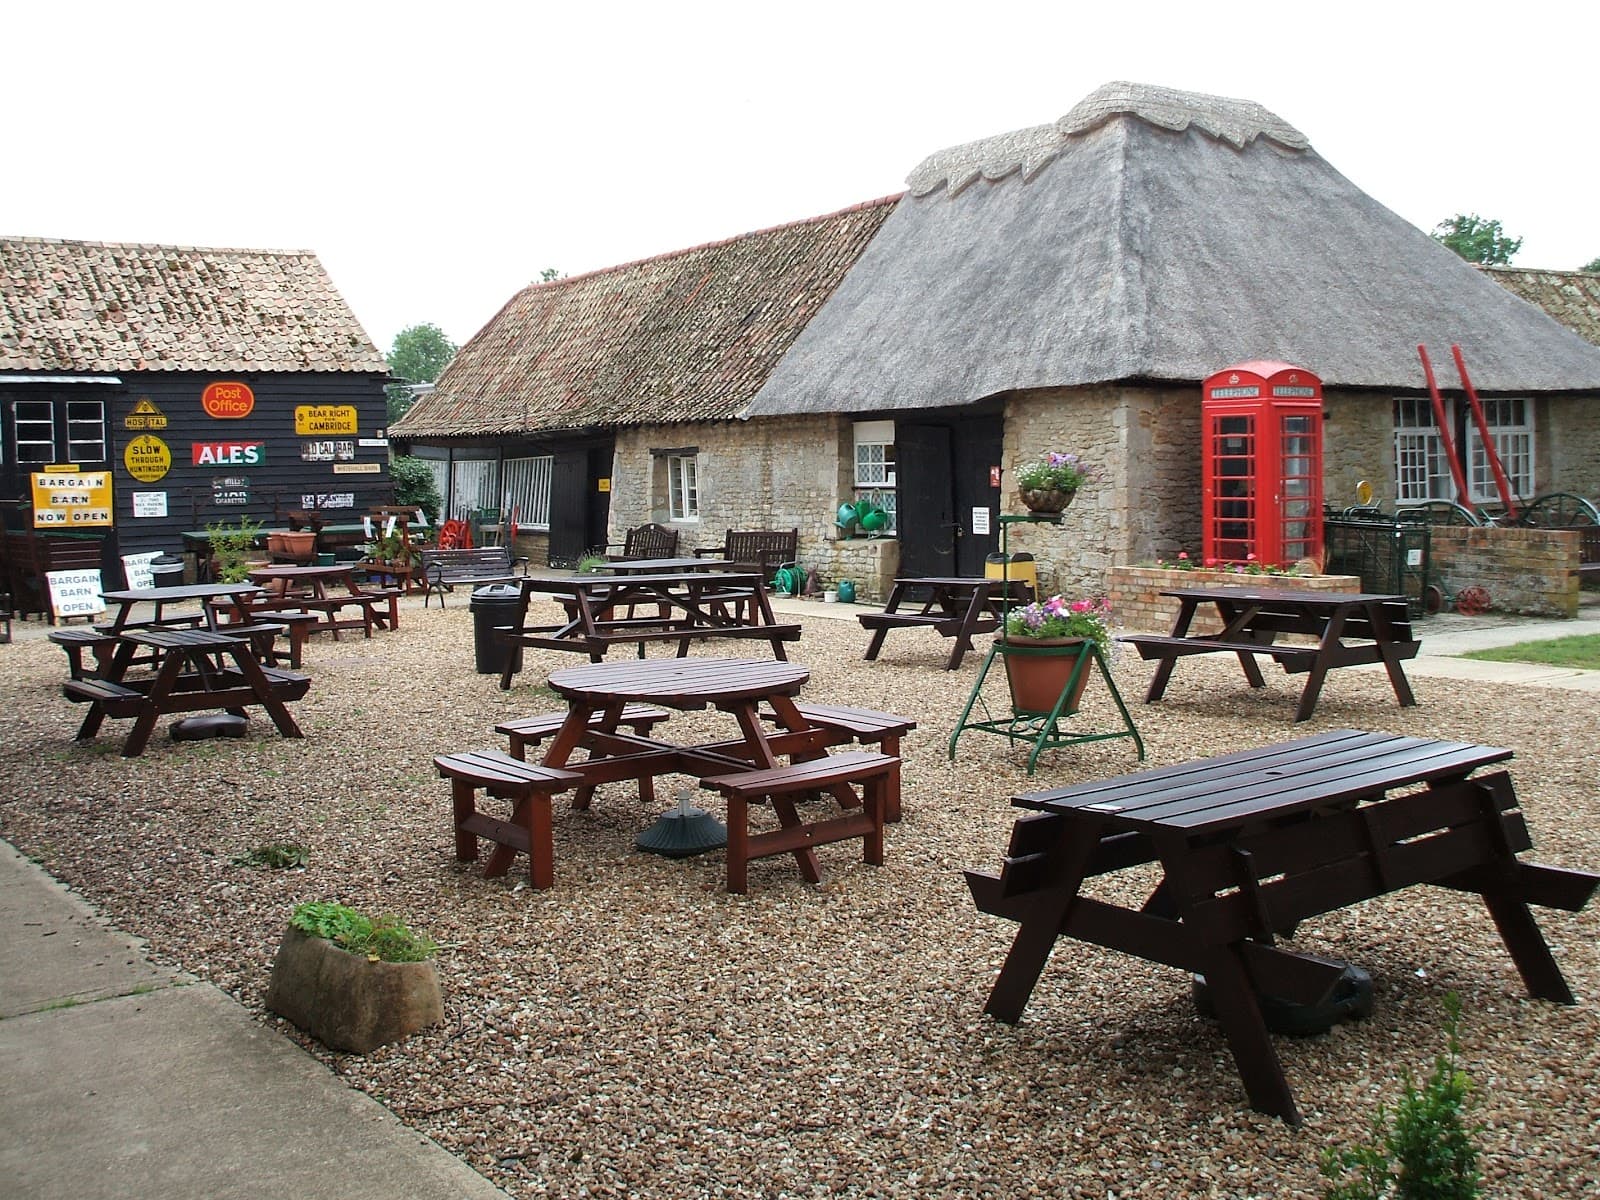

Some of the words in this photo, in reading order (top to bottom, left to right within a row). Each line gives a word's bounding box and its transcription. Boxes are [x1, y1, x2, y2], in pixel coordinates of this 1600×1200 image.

[215, 387, 241, 399] Post
[1213, 388, 1257, 397] TELEPHONE
[1275, 388, 1312, 396] TELEPHONE
[209, 400, 248, 412] Office
[308, 409, 327, 417] BEAR
[329, 409, 350, 417] RIGHT
[309, 422, 352, 431] CAMBRIDGE
[132, 446, 161, 455] SLOW
[198, 445, 259, 464] ALES
[130, 465, 168, 473] HUNTINGDON
[39, 478, 104, 487] BARGAIN
[51, 496, 89, 504] BARN
[37, 513, 66, 521] NOW
[73, 512, 109, 521] OPEN
[125, 558, 150, 567] BARG
[134, 568, 153, 577] BAR
[50, 575, 100, 586] BARGAIN
[136, 579, 155, 588] OPE
[60, 587, 92, 597] BARN
[63, 602, 93, 612] OPEN
